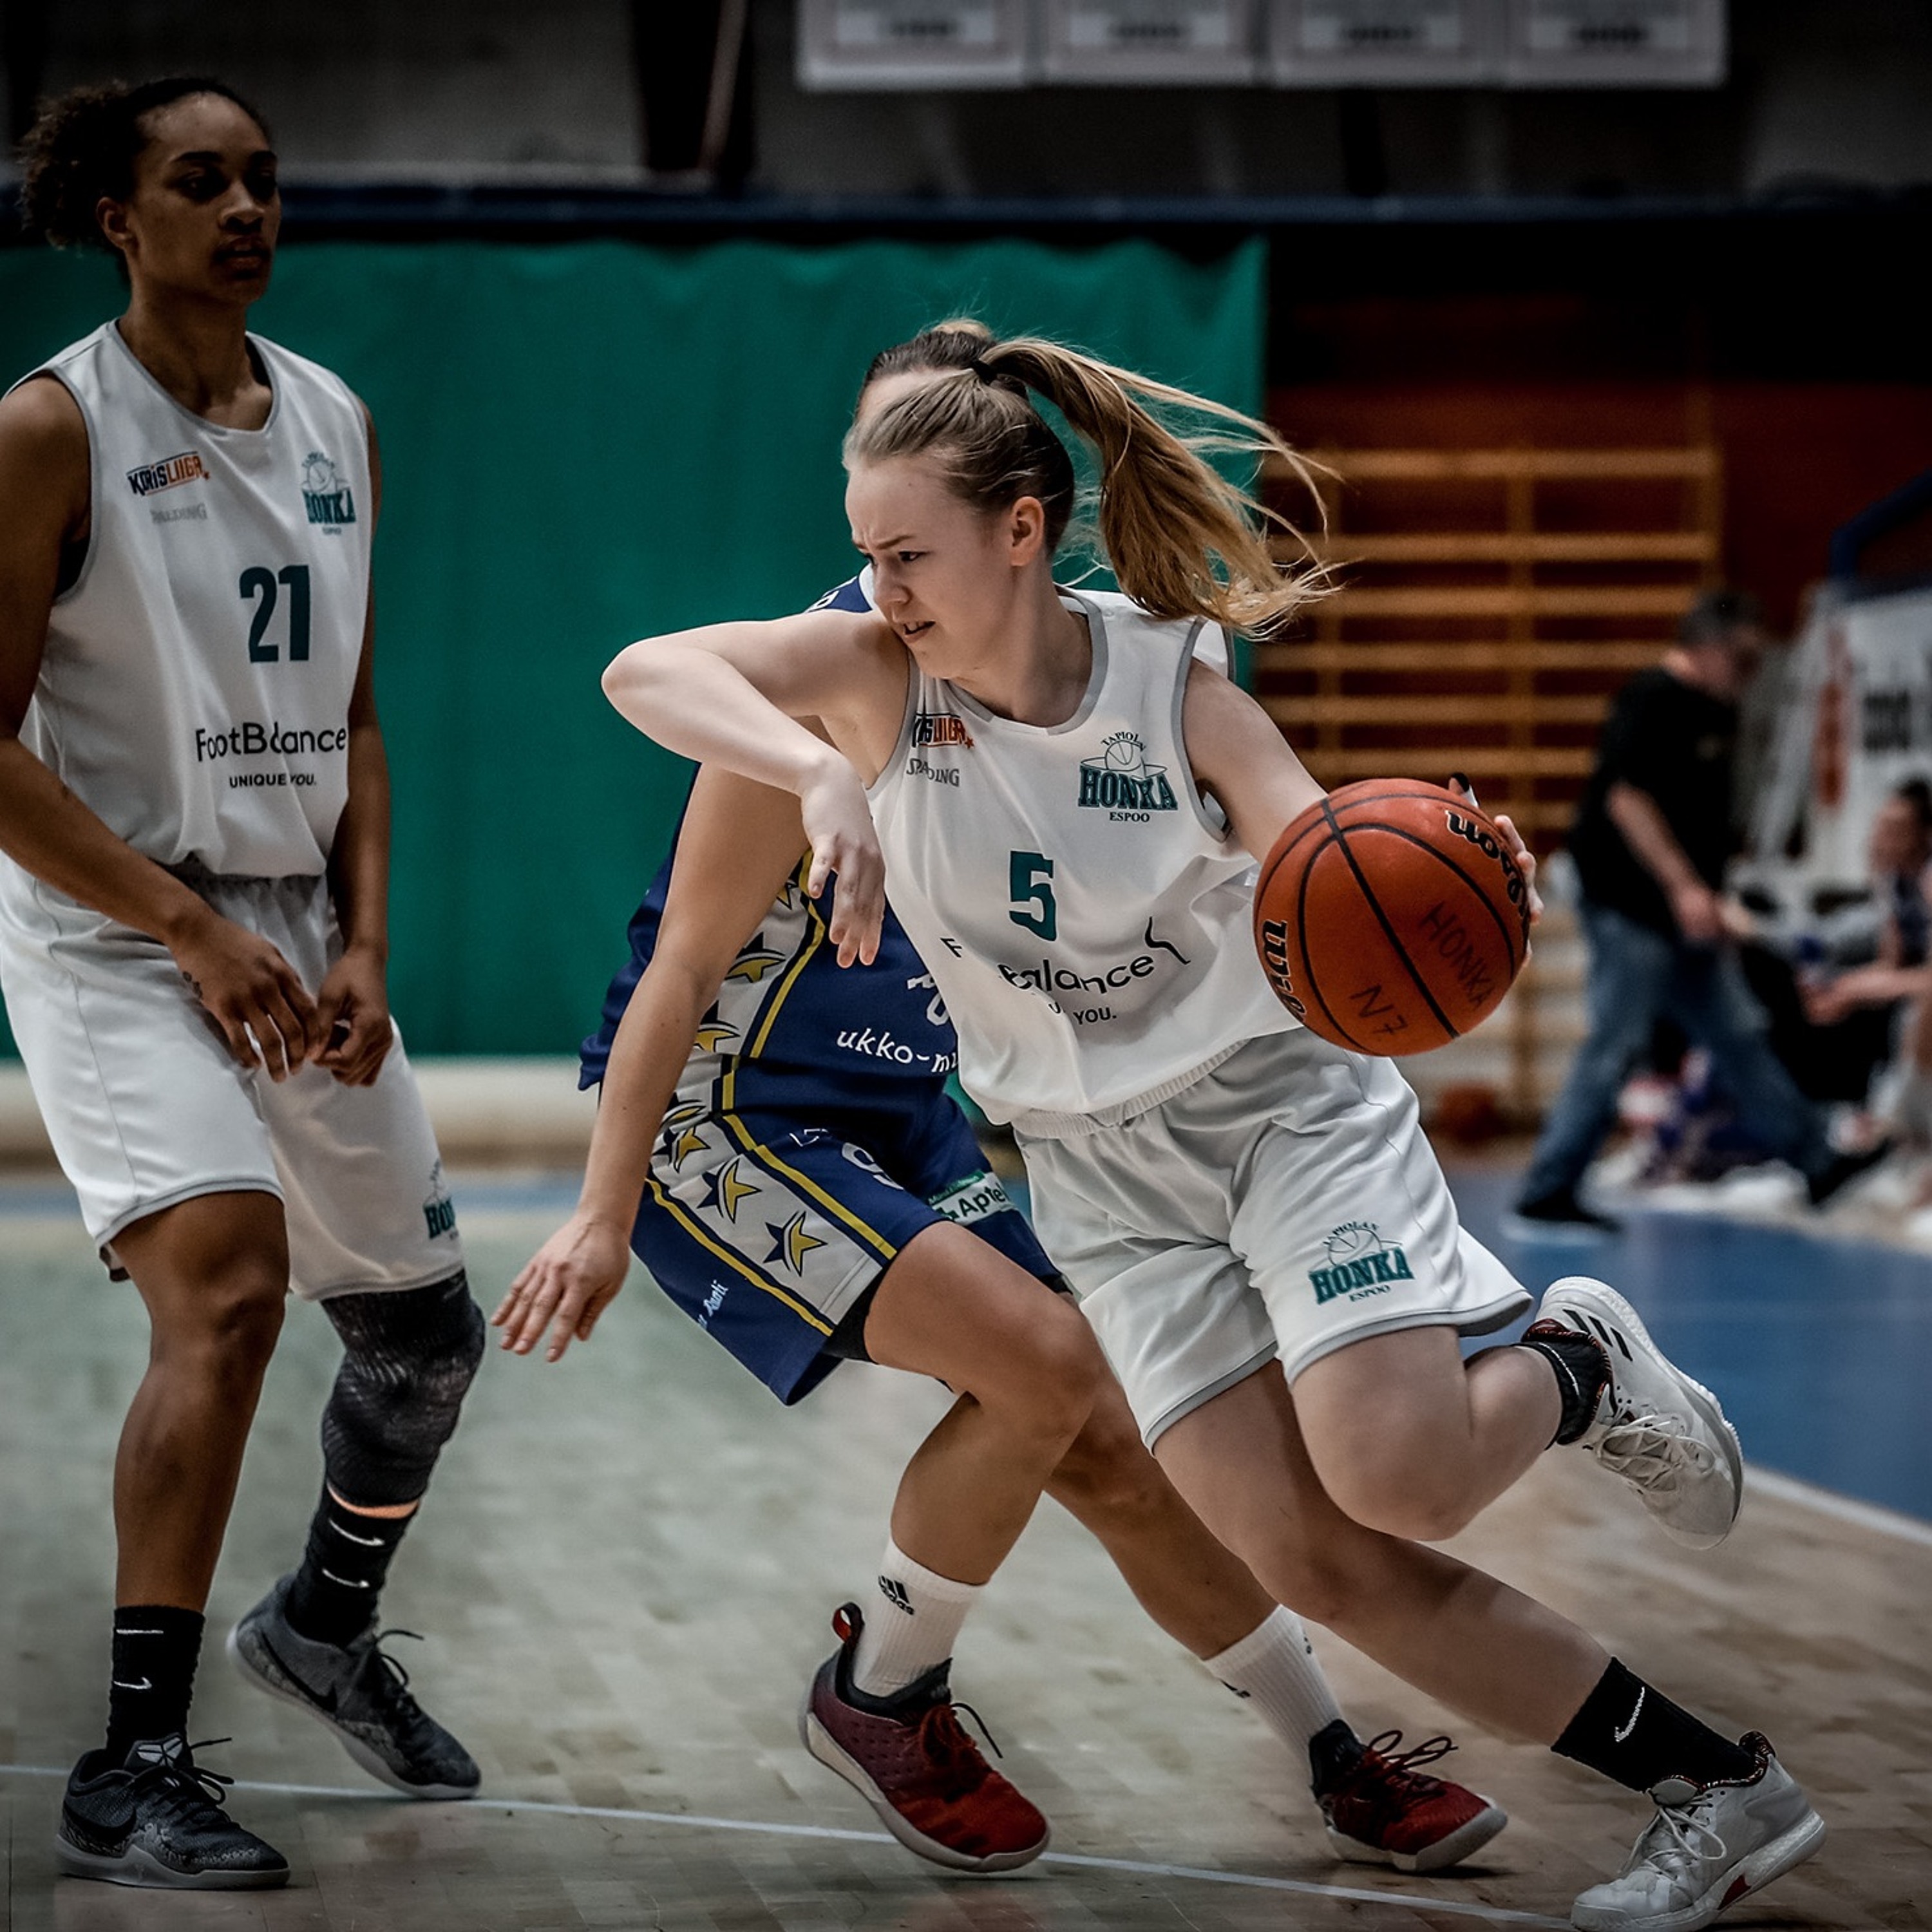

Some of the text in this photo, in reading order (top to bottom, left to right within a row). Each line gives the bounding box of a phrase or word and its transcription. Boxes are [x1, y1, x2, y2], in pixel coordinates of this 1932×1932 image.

[239, 565, 310, 663] 21
[229, 774, 287, 788] UNIQUE
[906, 758, 960, 787] SPADING
[1078, 765, 1179, 811] HONKA
[1109, 811, 1150, 823] ESPOO
[1009, 850, 1057, 942] 5
[1418, 901, 1495, 1012] HONKA
[1072, 1007, 1117, 1025] YOU.
[1308, 1247, 1415, 1305] HONKA
